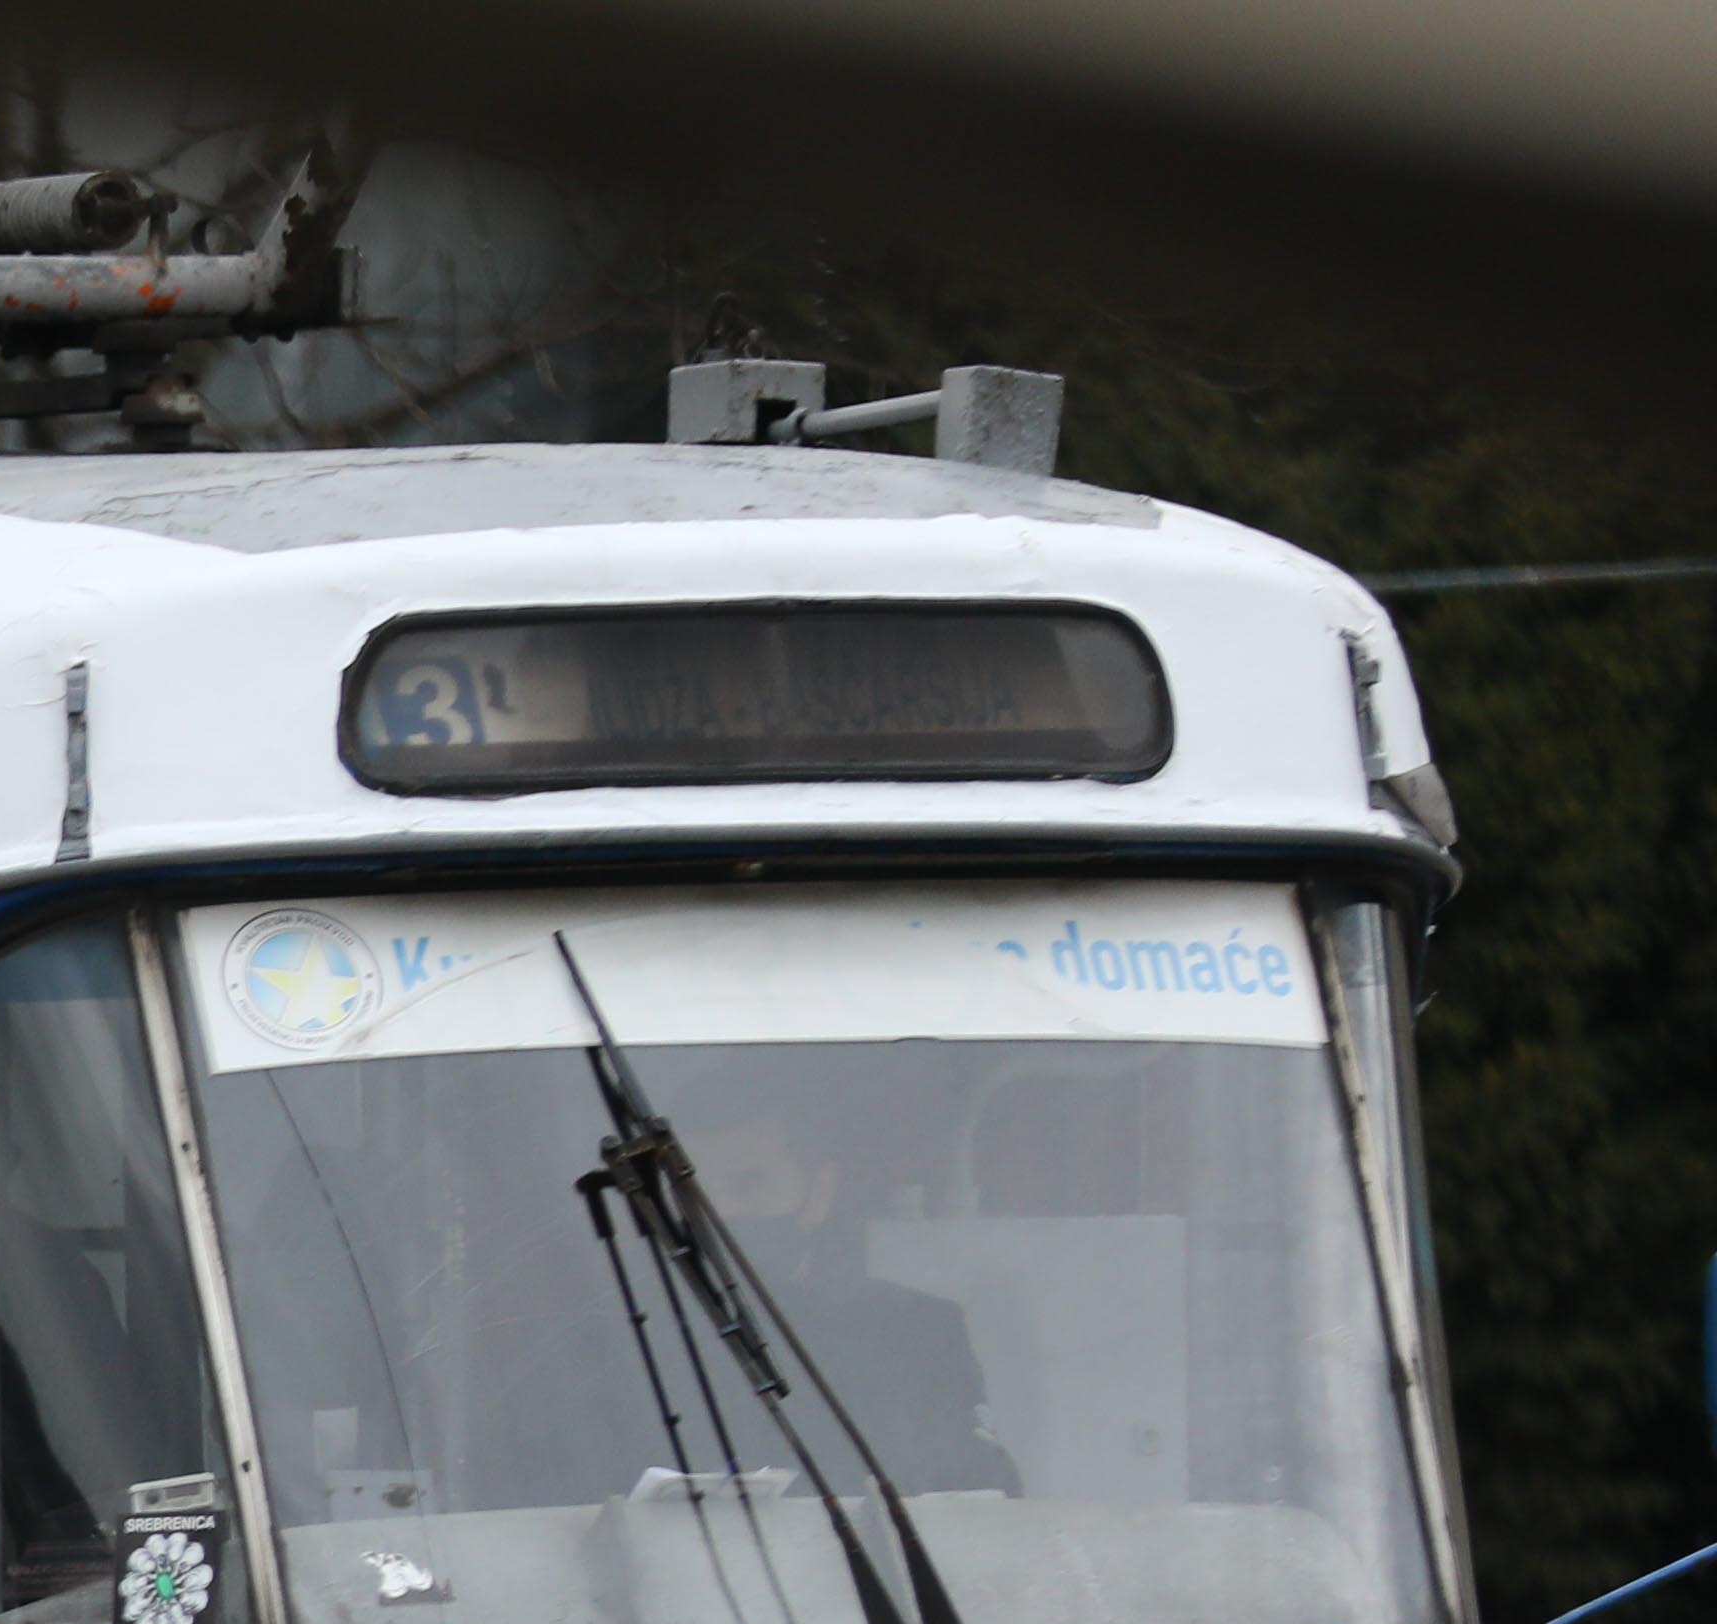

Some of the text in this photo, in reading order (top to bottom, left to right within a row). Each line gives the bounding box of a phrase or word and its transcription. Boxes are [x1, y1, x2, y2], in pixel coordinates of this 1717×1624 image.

[396, 663, 474, 744] 3
[1050, 919, 1294, 997] domaće
[123, 1514, 216, 1535] SREBRENICA
